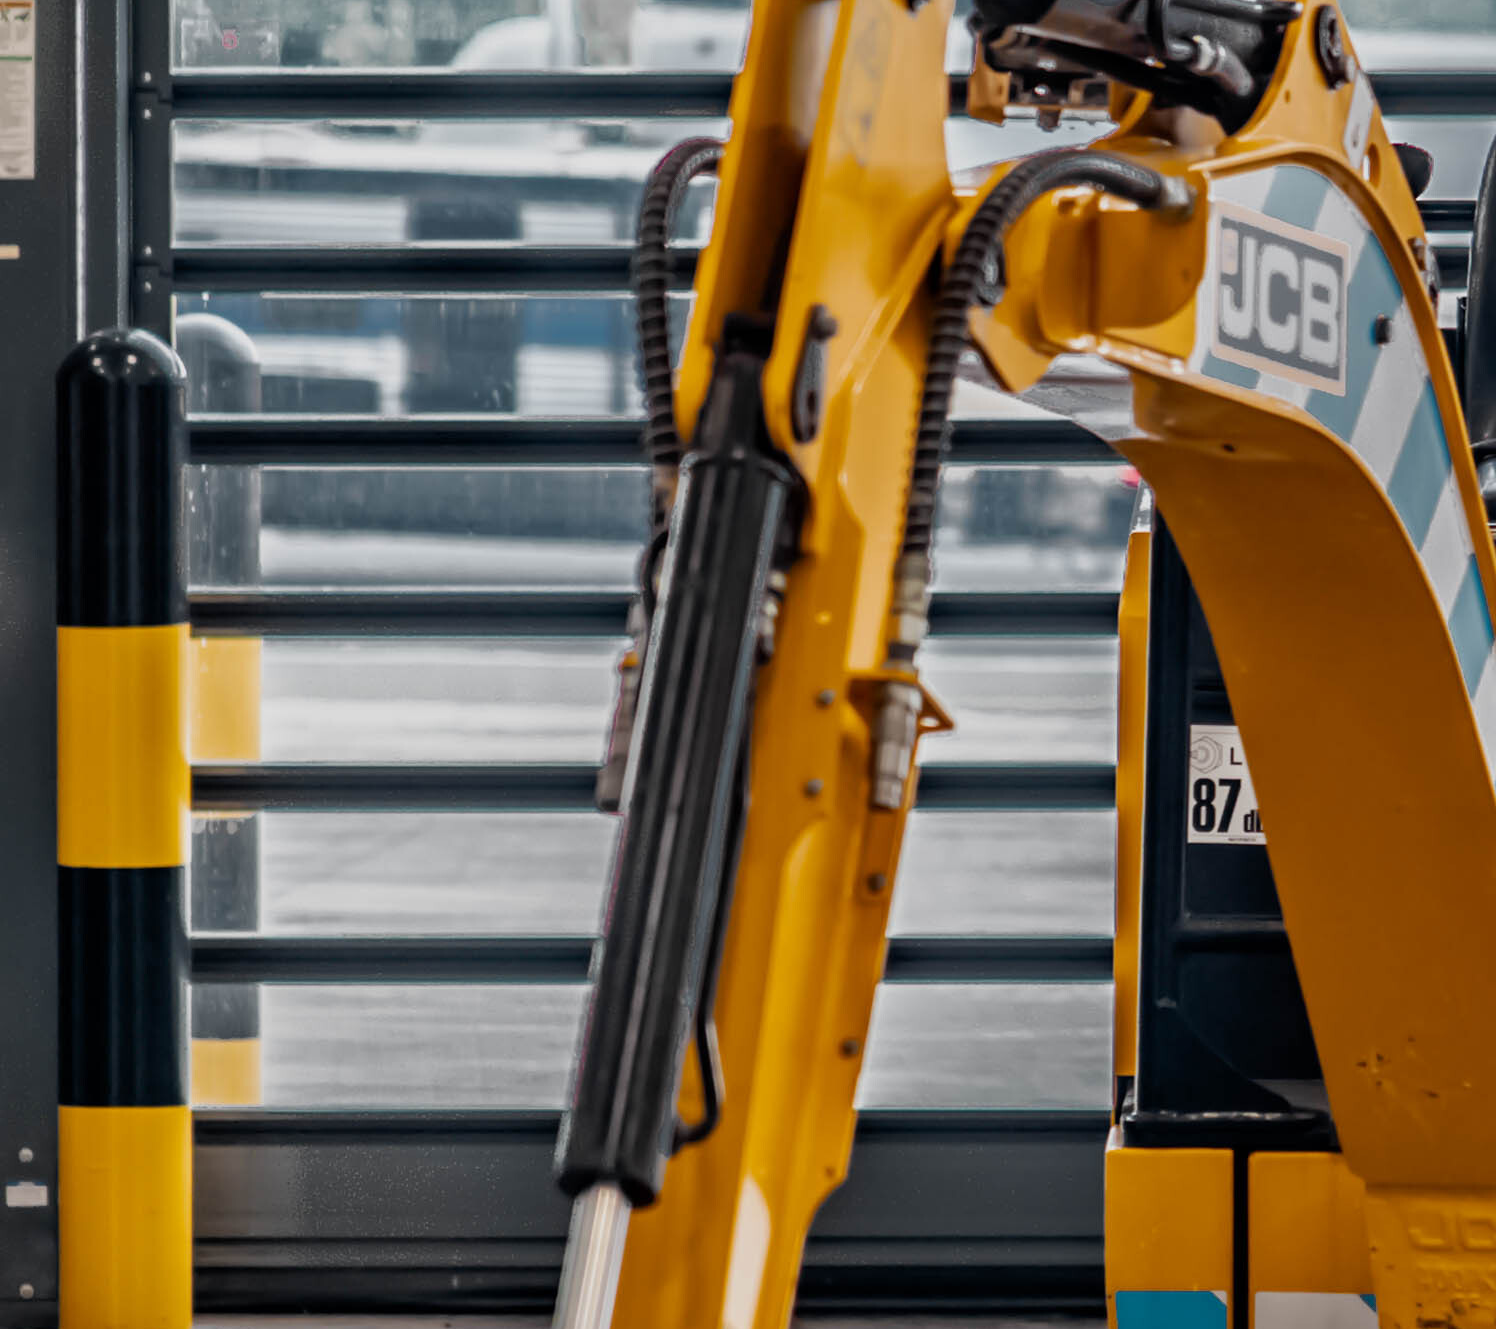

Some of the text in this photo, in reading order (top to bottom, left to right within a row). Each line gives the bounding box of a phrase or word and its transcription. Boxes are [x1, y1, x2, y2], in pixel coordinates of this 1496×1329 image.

[1221, 235, 1340, 368] JCB
[1230, 747, 1243, 765] L
[1192, 777, 1242, 833] 87
